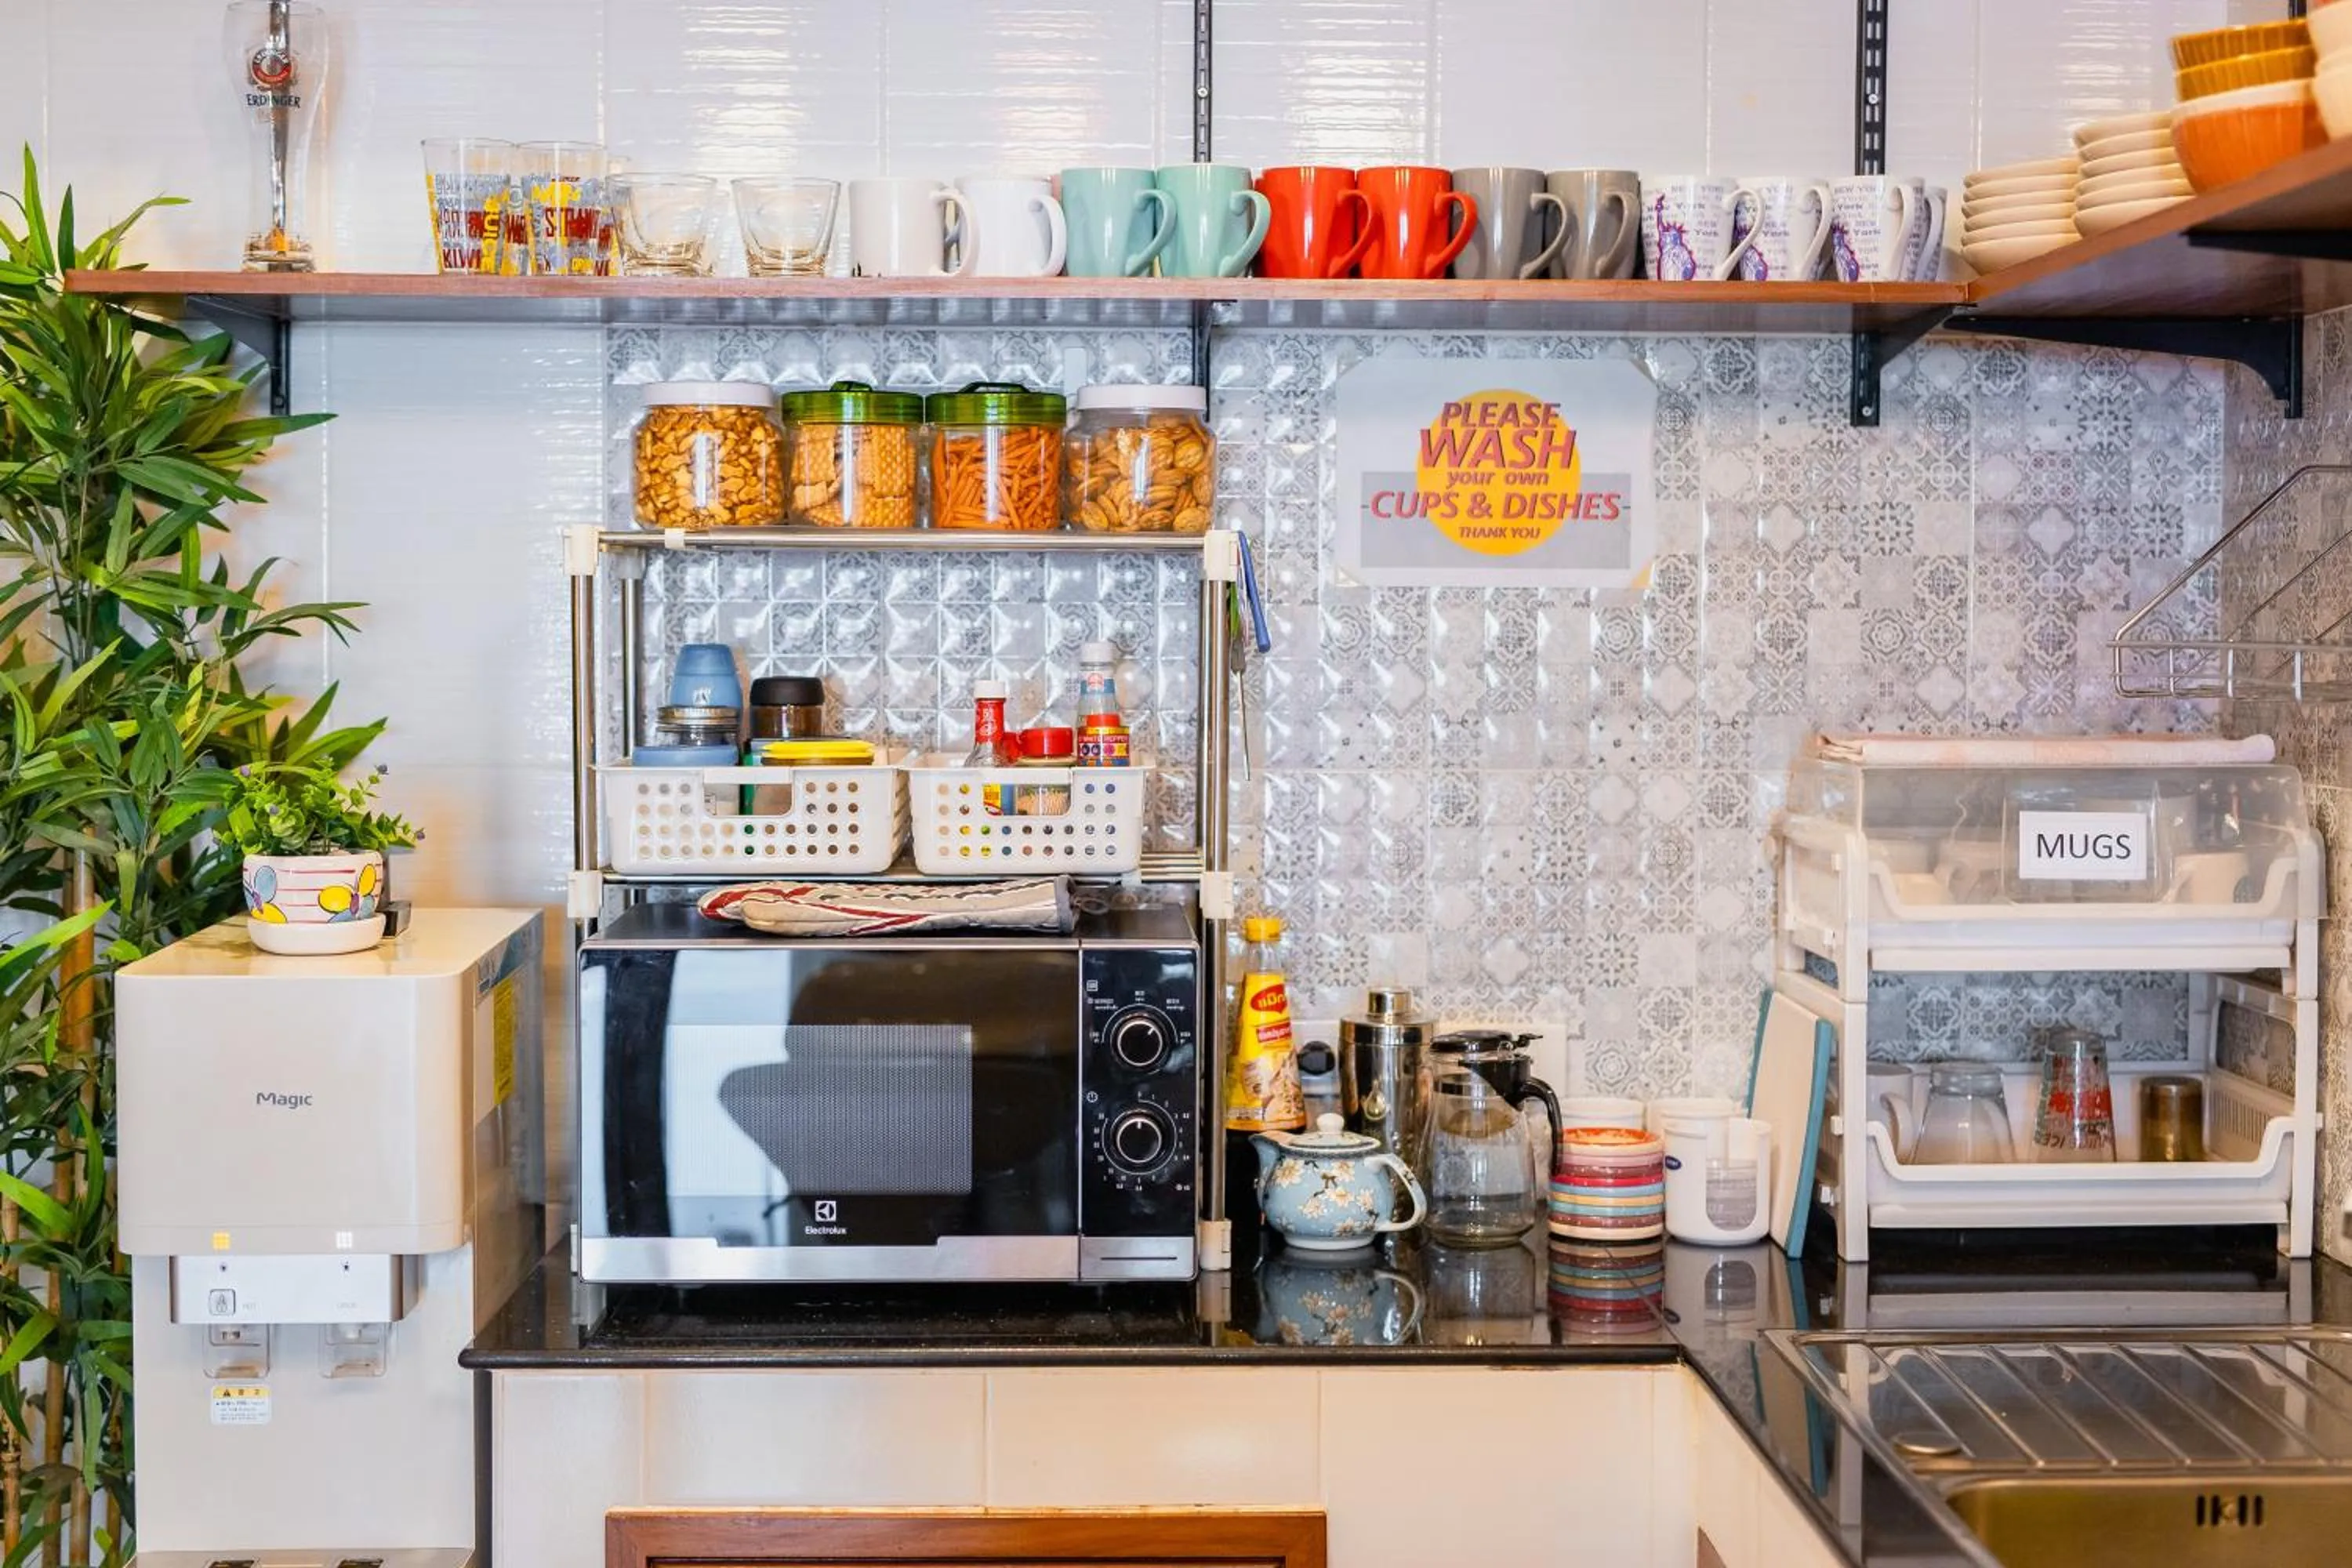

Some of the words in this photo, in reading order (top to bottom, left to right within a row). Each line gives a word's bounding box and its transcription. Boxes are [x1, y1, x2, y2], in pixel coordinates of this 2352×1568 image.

[245, 93, 301, 108] ERDINGER
[1441, 401, 1562, 428] PLEASE
[1420, 428, 1577, 469] WASH
[1446, 471, 1495, 489] your
[1504, 471, 1550, 486] own
[1370, 490, 1460, 519] CUPS
[1465, 491, 1494, 521] &
[1501, 492, 1621, 521] DISHES
[1458, 526, 1508, 539] THANK
[1510, 526, 1541, 539] YOU
[2036, 833, 2132, 860] MUGS
[256, 1092, 314, 1110] Magic
[804, 1225, 848, 1235] Electrolux
